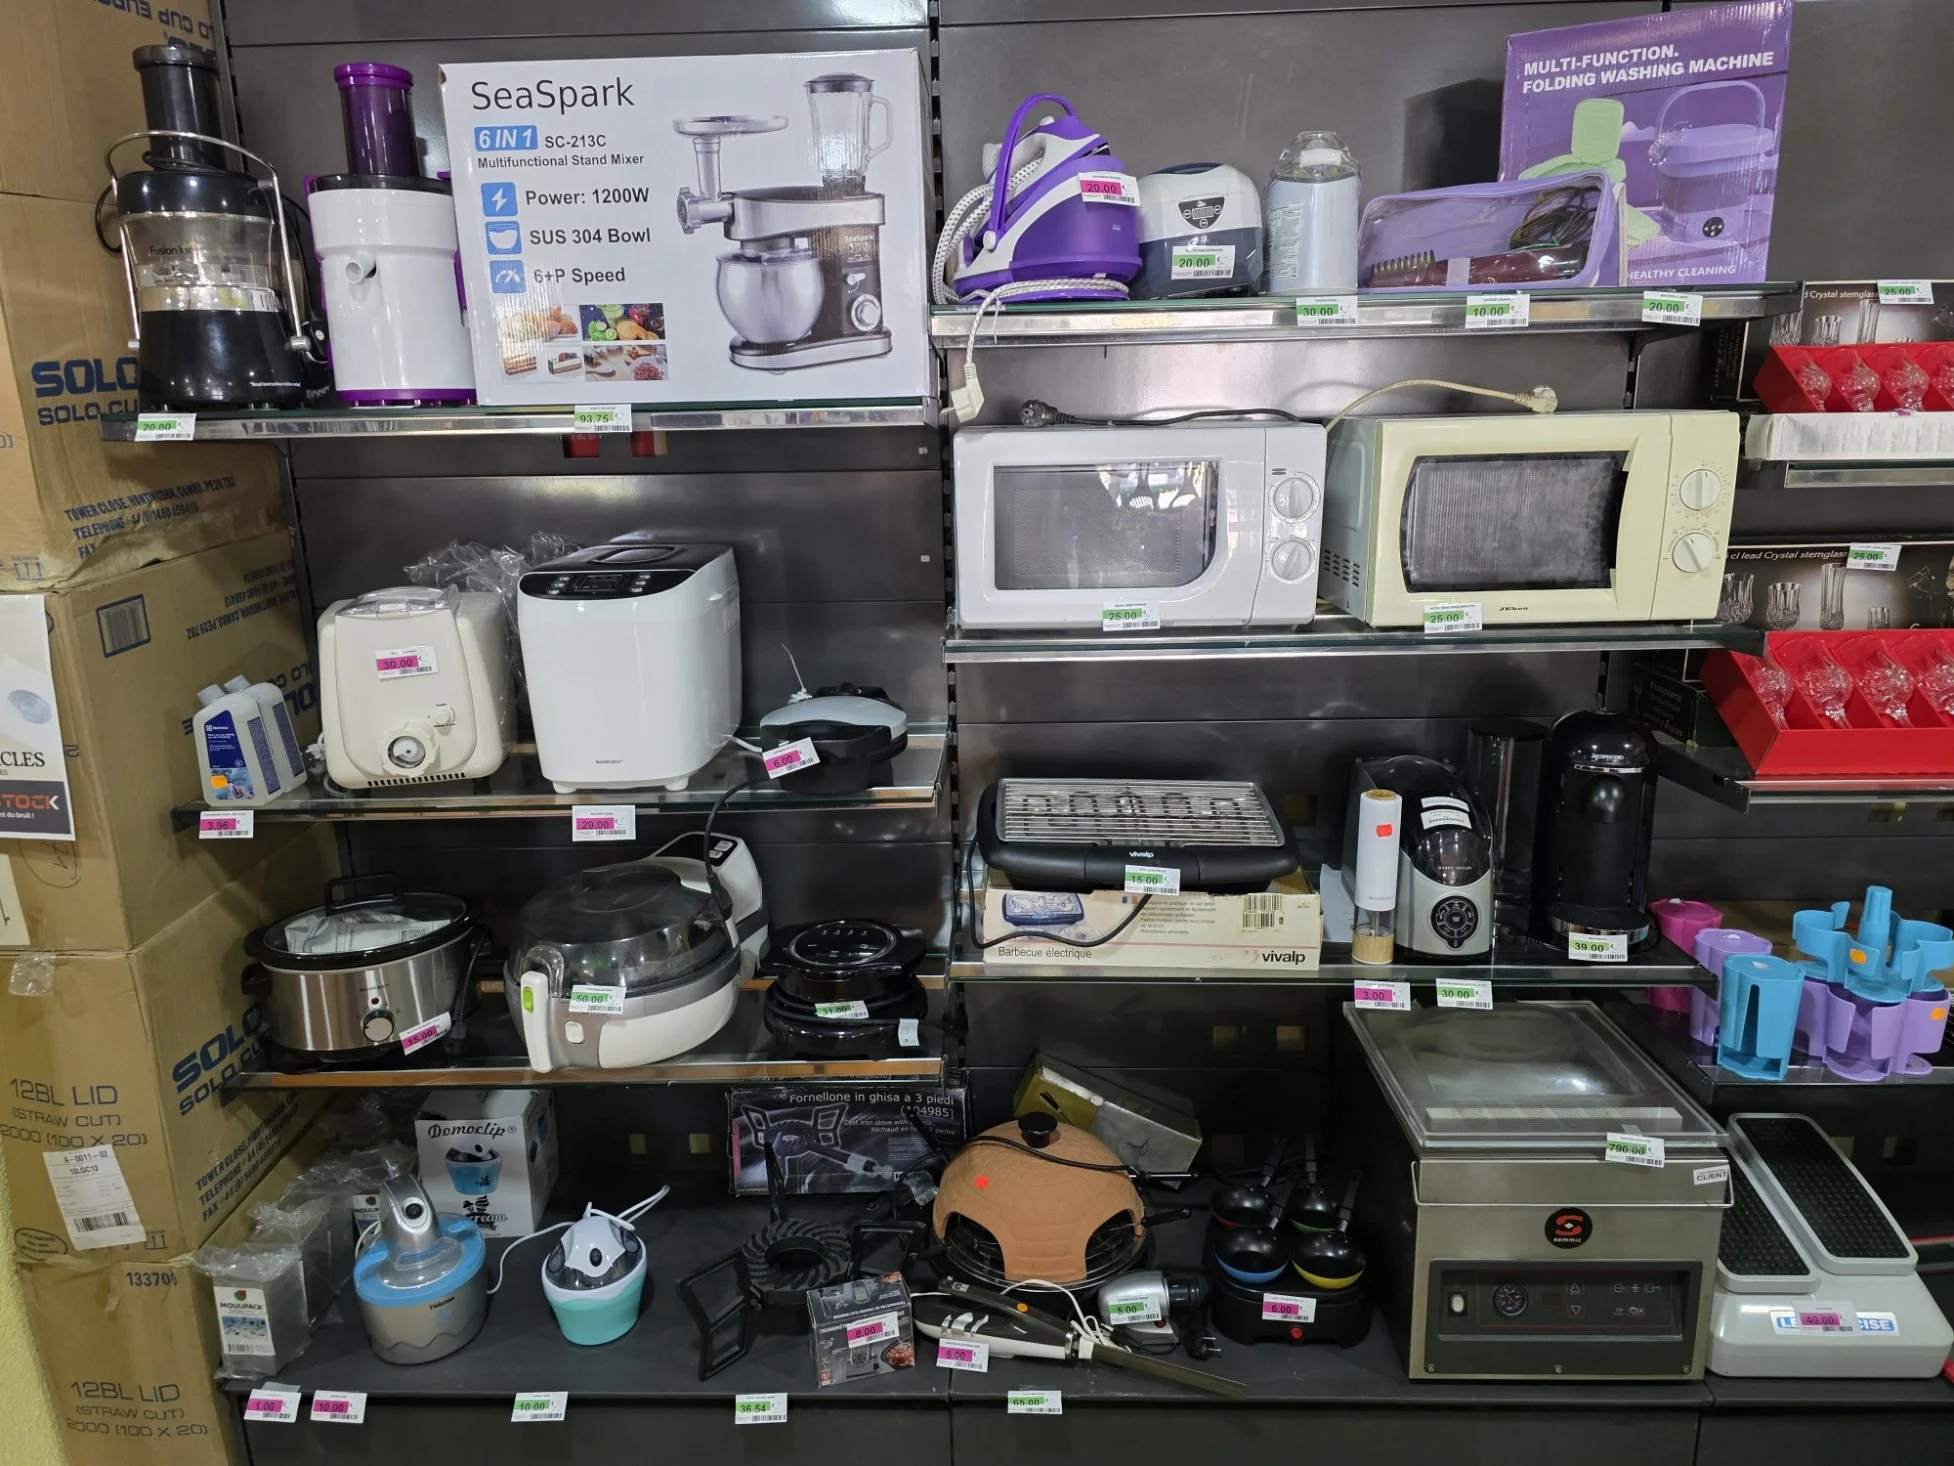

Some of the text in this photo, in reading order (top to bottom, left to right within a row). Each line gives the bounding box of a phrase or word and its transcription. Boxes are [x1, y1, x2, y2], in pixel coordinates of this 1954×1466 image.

[1522, 52, 1774, 94] FOLDING WASHING MACHINE
[470, 77, 635, 114] SeaSpark
[478, 128, 607, 149] 6 IN 1 SC-213C
[478, 153, 645, 168] Multifunctional Stand Mixer
[1086, 182, 1116, 194] 20.00
[525, 186, 650, 206] Power: 1200W
[530, 226, 652, 246] SUS 304 Bowl
[1179, 258, 1210, 268] 20.00
[533, 266, 627, 288] 6+P Speed
[1678, 265, 1736, 278] CLEANING
[1809, 290, 1838, 300] Crystal
[1884, 288, 1911, 296] 25.00
[1304, 307, 1333, 316] 30.00
[1472, 306, 1504, 317] 10.00
[1648, 302, 1680, 313] 20.00
[37, 402, 100, 426] SOLO
[580, 414, 609, 423] 93.75
[142, 422, 172, 432] 20.00
[1740, 551, 1762, 560] lead
[1764, 550, 1799, 561] Crystal
[1852, 552, 1879, 562] 25.00
[1108, 610, 1138, 622] 25.00
[1430, 612, 1460, 624] 25.00
[382, 657, 414, 670] 30.00
[0, 751, 46, 768] CLES
[773, 754, 794, 768] 6.00
[0, 794, 60, 811] TOCK
[206, 820, 230, 830] 3.96
[582, 820, 610, 830] 29.00
[1128, 850, 1154, 858] vivalp
[1130, 875, 1158, 886] 15.00
[1574, 942, 1604, 953] 39.00
[998, 946, 1306, 965] Barbecue électrique vivalp
[575, 994, 604, 1004] 50.00
[1362, 990, 1384, 1000] 3.00
[1441, 989, 1470, 999] 30.00
[408, 1030, 433, 1046] 15.00
[170, 1000, 265, 1094] SOLO
[10, 1078, 118, 1107] 12BL LID
[178, 1060, 236, 1116] SOLO
[789, 1092, 954, 1105] Fornellone in ghisa a 3 piedi
[12, 1107, 122, 1128] (STRAW CUT)
[46, 1132, 84, 1149] (100
[112, 1132, 148, 1147] 20)
[1608, 1142, 1646, 1156] 790.00
[1696, 1172, 1727, 1182] CLIENT
[218, 1301, 264, 1312] MOULIPACK
[1117, 1305, 1137, 1315] 5.00
[1271, 1304, 1292, 1314] 6.00
[1806, 1314, 1834, 1325] 40.00
[856, 1326, 876, 1338] 8.00
[70, 1380, 182, 1403] 12BL LID
[76, 1404, 186, 1421] (STRAW CUT)
[255, 1402, 276, 1412] 1.00
[318, 1402, 344, 1413] 10.00
[518, 1401, 546, 1412] 10.00
[740, 1402, 768, 1414] 36.54
[114, 1422, 154, 1437] (100
[176, 1423, 208, 1437] 20)
